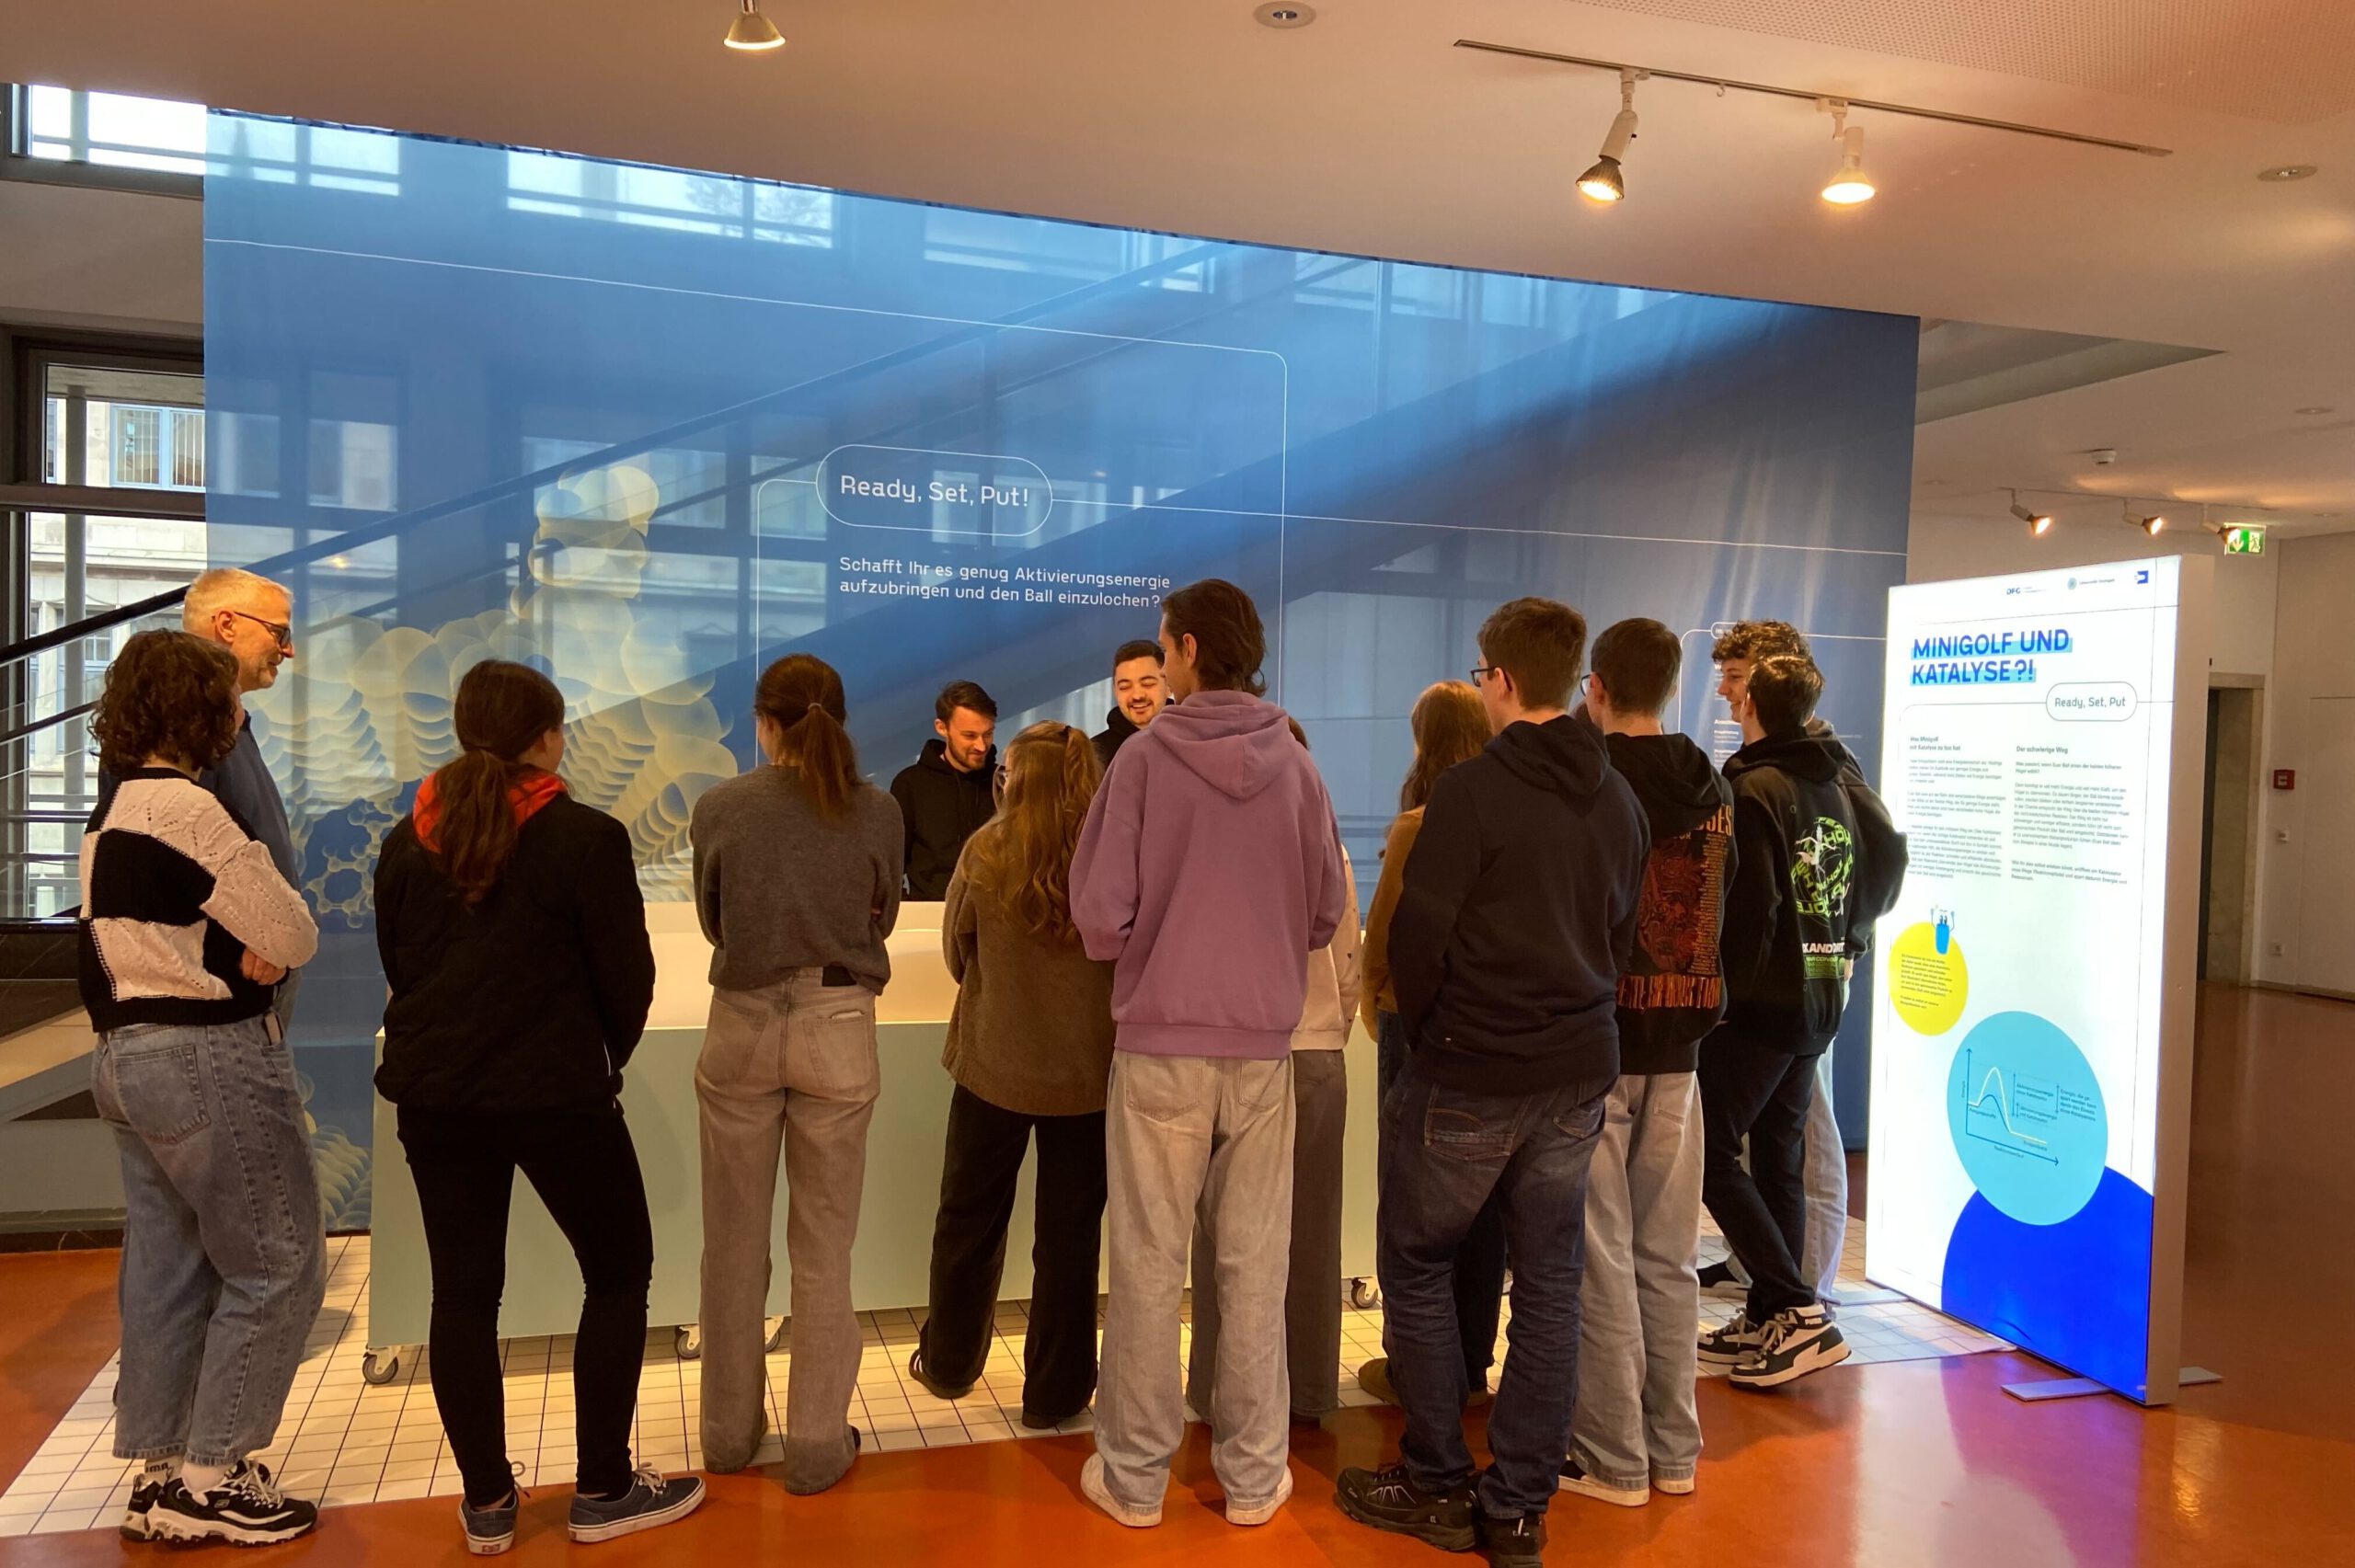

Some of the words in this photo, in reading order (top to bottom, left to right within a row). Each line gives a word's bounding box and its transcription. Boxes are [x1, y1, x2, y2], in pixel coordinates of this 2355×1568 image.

[842, 475, 921, 503] Ready,
[929, 482, 973, 506] Set,
[982, 486, 1028, 506] Put!
[840, 557, 902, 573] Schafft
[910, 561, 929, 575] Ihr
[936, 567, 953, 578] es
[959, 567, 1008, 582] genug
[1015, 567, 1169, 589] Aktivierungsenergie
[840, 580, 949, 599] aufzubringen
[956, 586, 984, 599] und
[991, 587, 1018, 601] den
[1025, 589, 1052, 602] Ball
[1059, 590, 1160, 607] einzulochen?
[1913, 633, 2013, 658] MINIGOLF
[2020, 629, 2069, 652] UND
[2055, 697, 2085, 708] Ready,
[2088, 697, 2107, 707] Set,
[2109, 697, 2125, 706] Put
